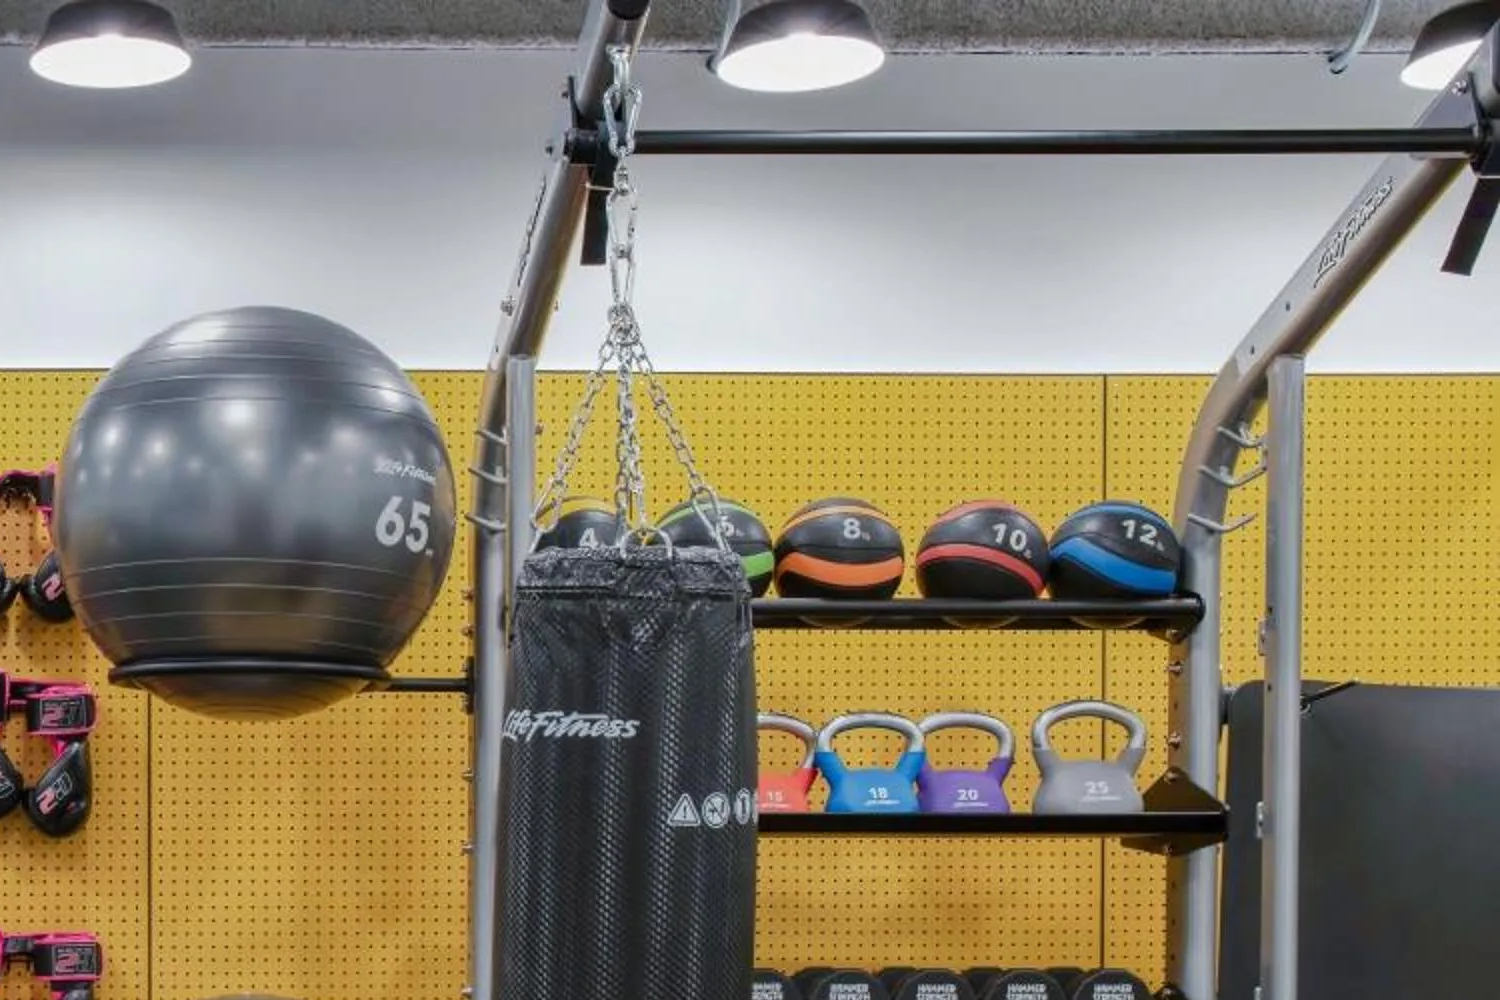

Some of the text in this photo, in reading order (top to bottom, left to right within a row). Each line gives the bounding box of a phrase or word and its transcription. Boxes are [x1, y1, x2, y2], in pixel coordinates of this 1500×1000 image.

[376, 496, 431, 553] 65
[843, 517, 861, 539] 8
[1121, 519, 1157, 547] 12
[992, 523, 1027, 552] 10
[956, 788, 979, 801] 20
[1084, 780, 1109, 794] 25
